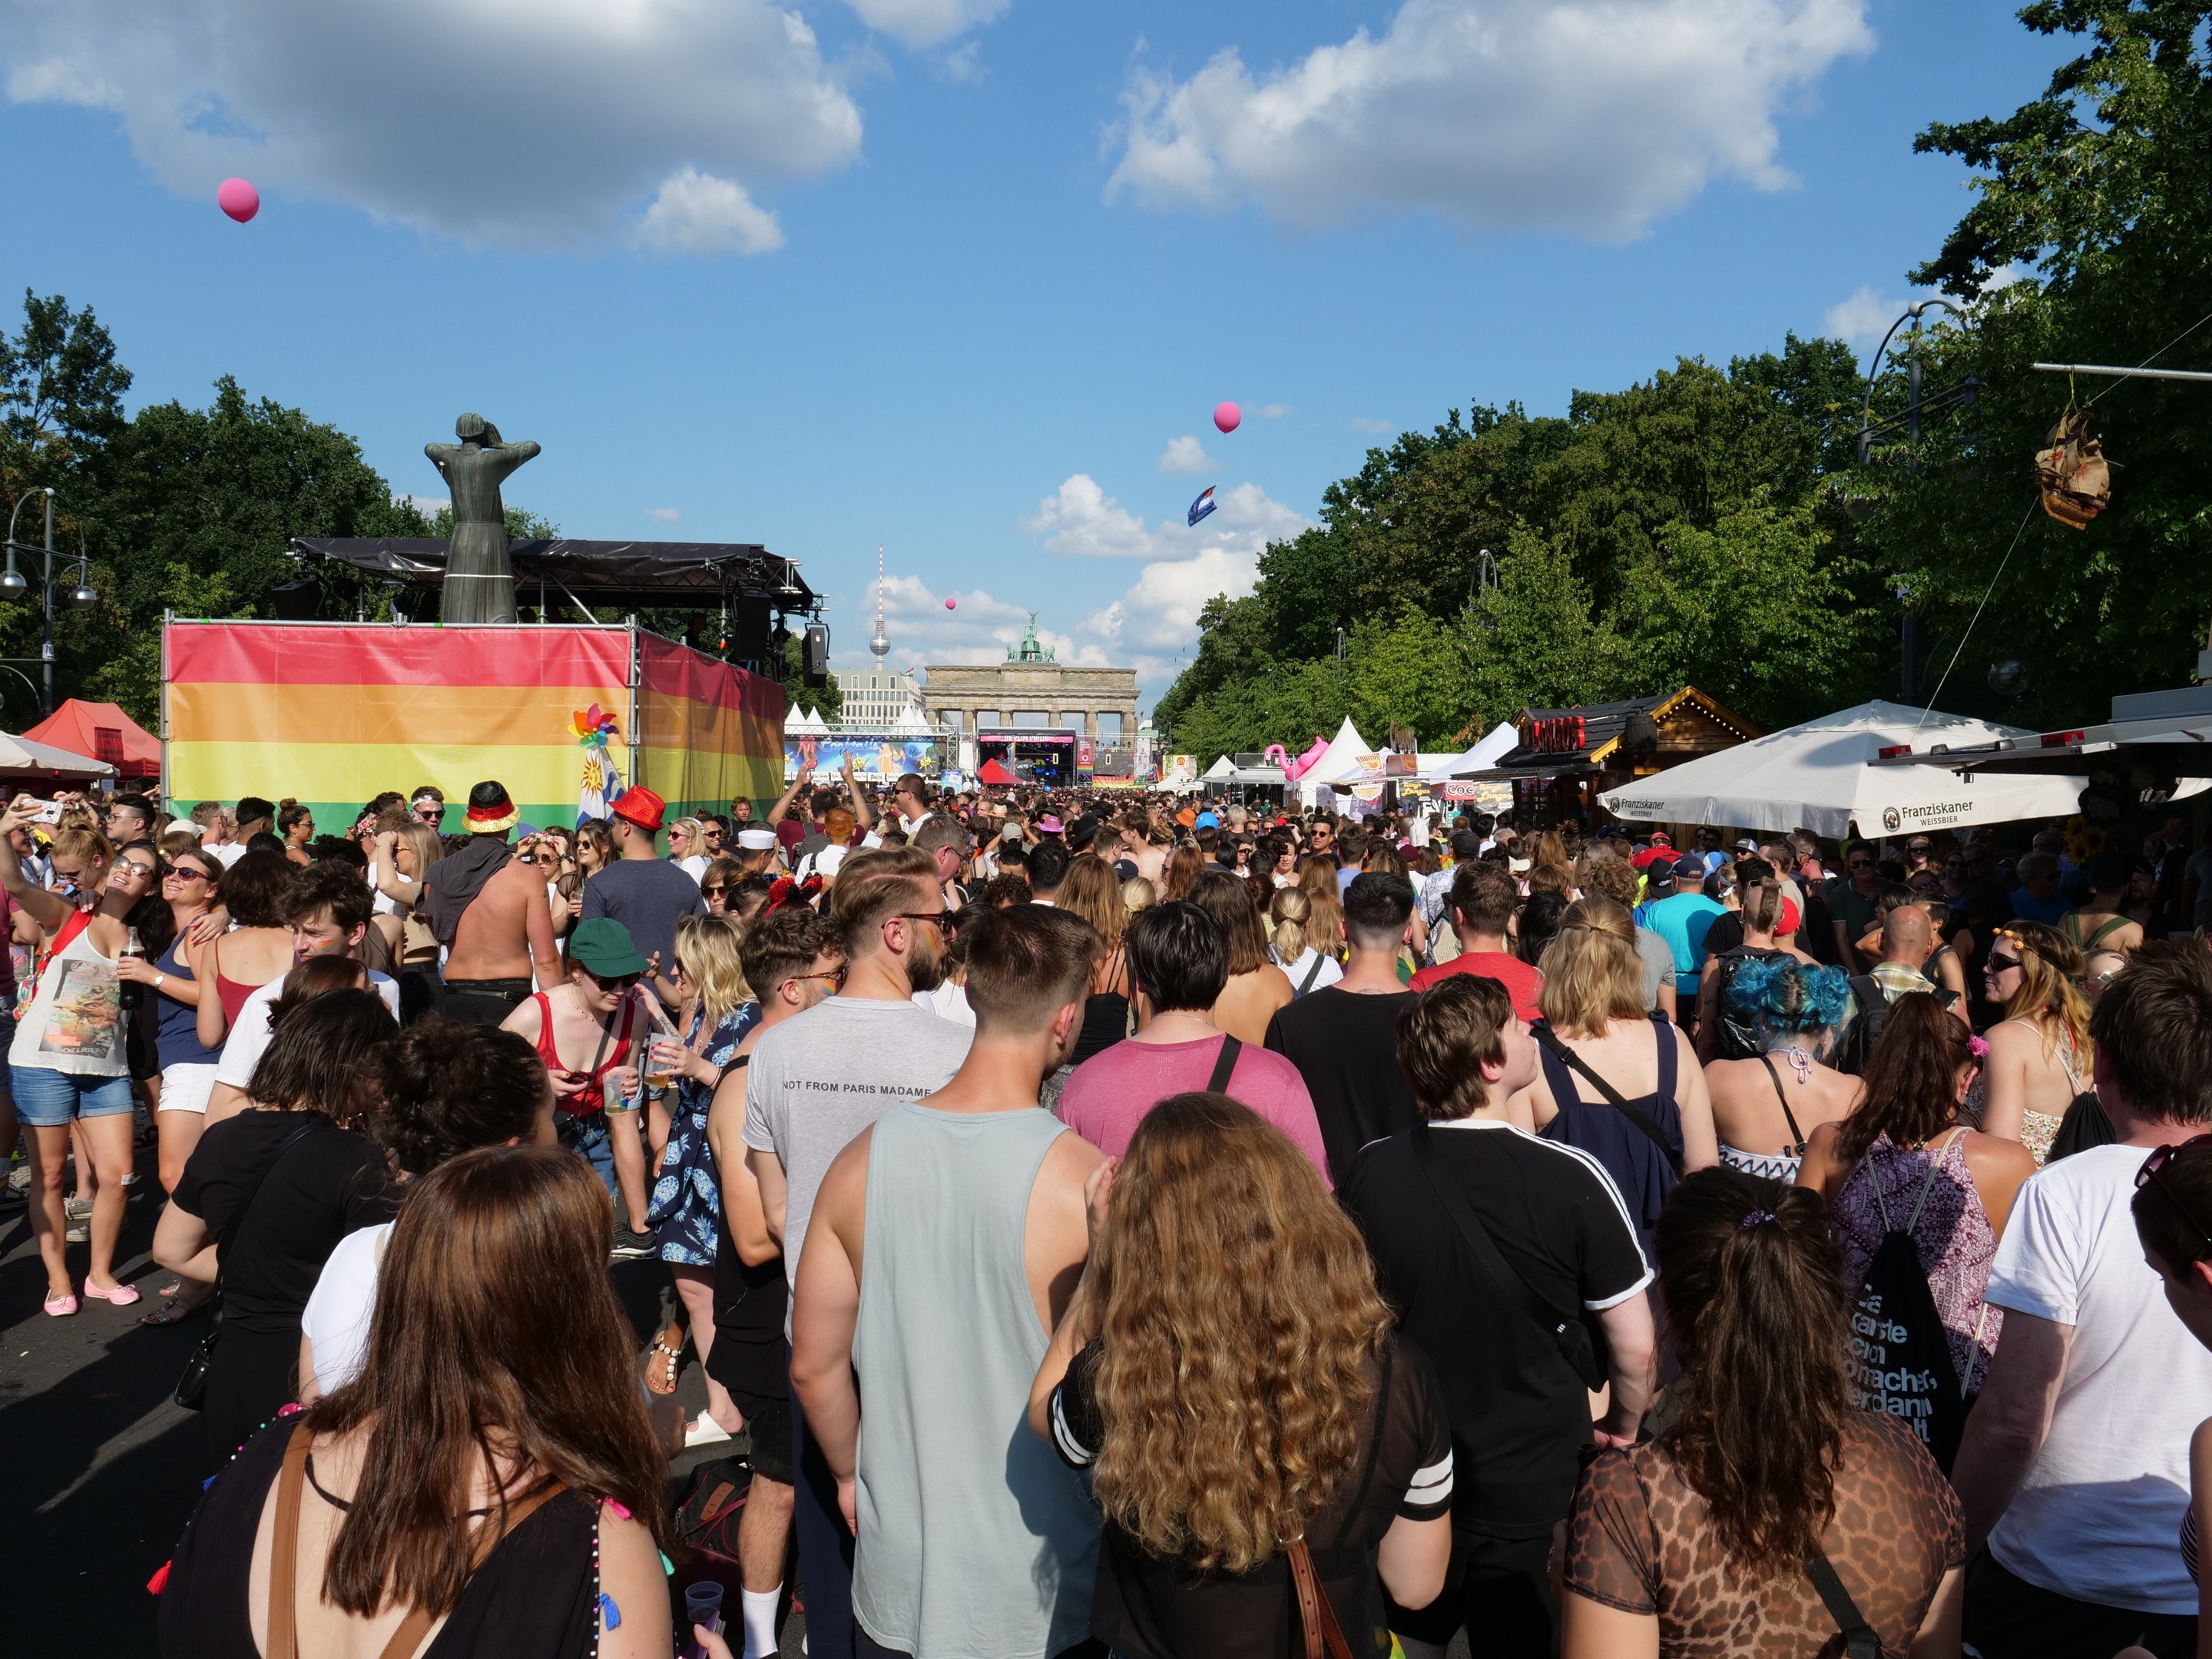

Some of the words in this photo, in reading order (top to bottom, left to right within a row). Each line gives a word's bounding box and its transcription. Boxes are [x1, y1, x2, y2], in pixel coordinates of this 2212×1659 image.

[1447, 784, 1474, 796] Coc
[1476, 791, 1512, 802] Langos
[1621, 799, 1664, 810] Franziskaner
[1902, 801, 1973, 819] Franziskaner
[1920, 816, 1958, 826] WEISSBIER
[783, 1081, 802, 1090] NOT
[806, 1081, 839, 1091] FROM
[843, 1084, 876, 1094] PARIS
[880, 1085, 932, 1097] MADAME
